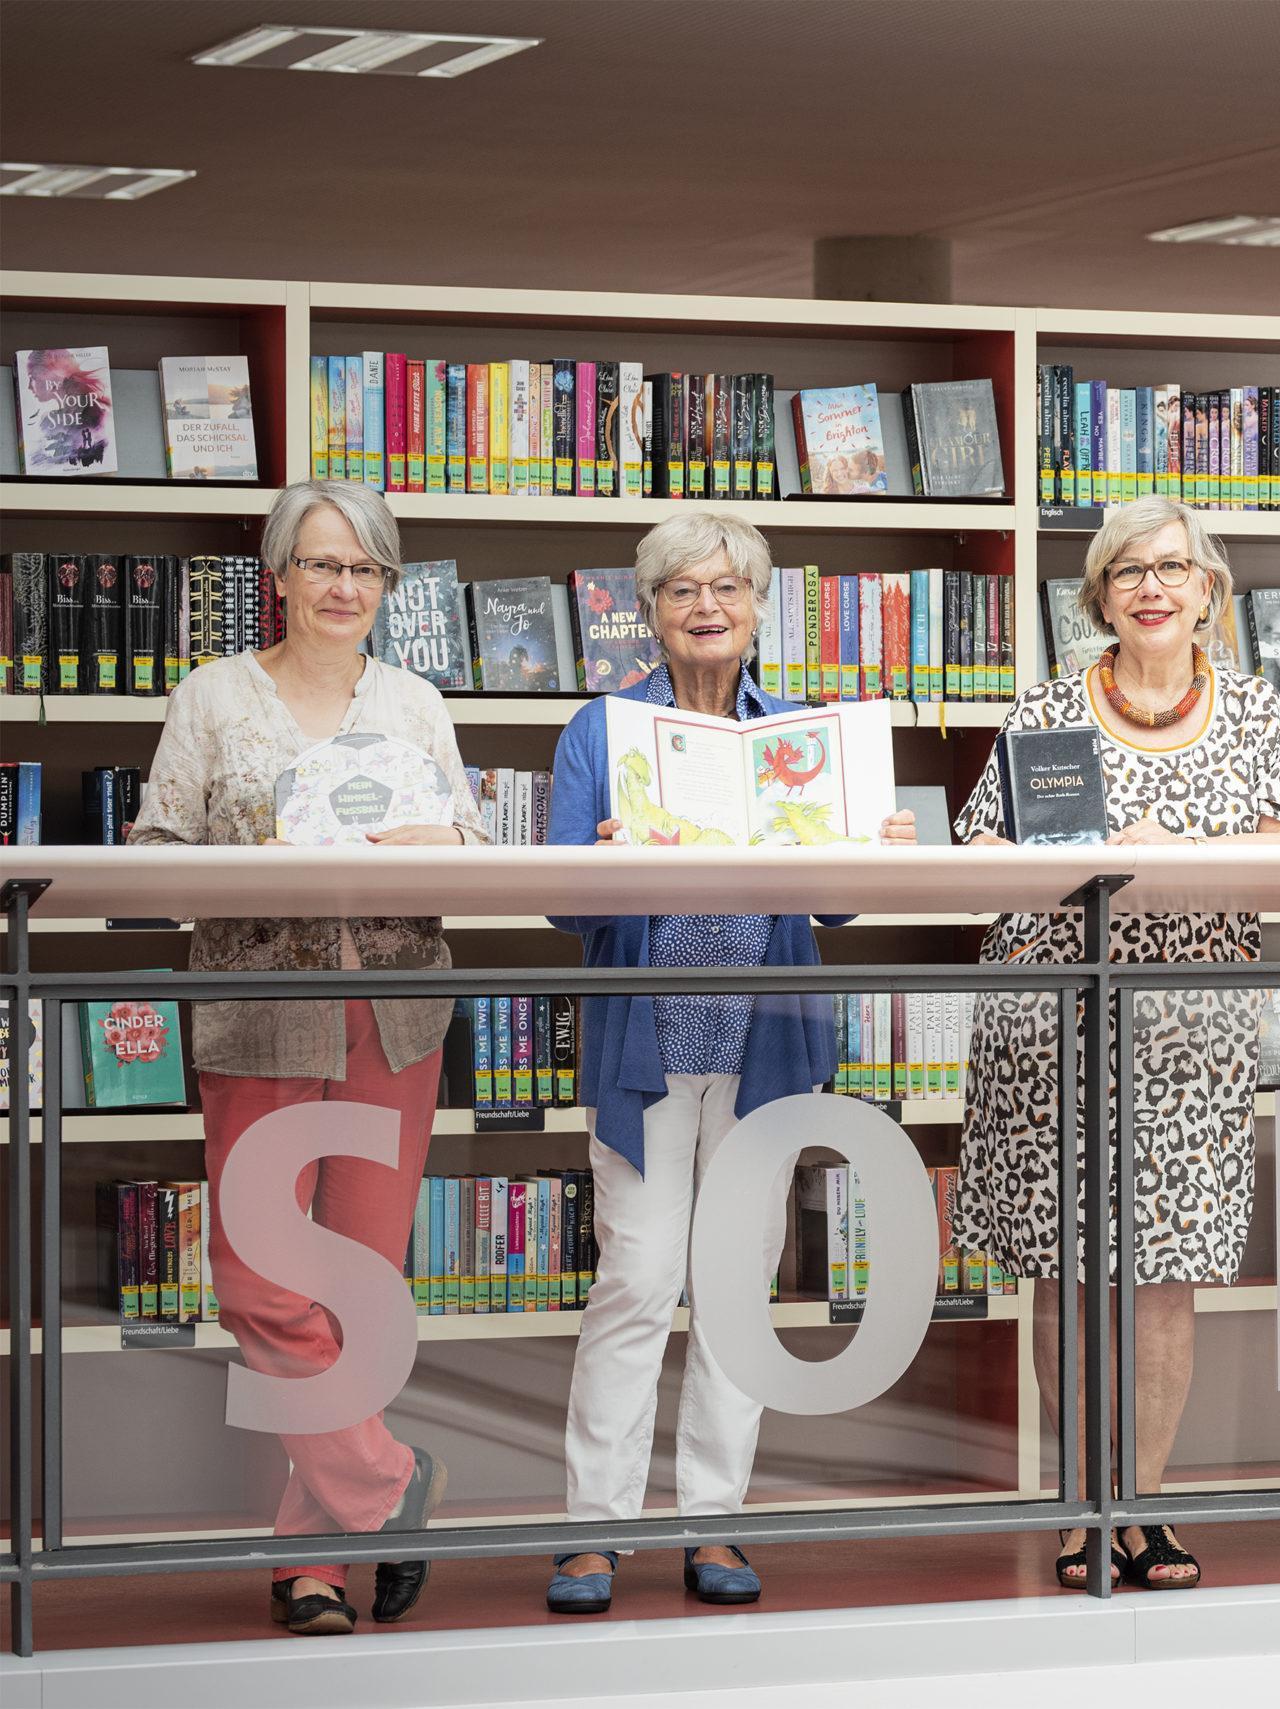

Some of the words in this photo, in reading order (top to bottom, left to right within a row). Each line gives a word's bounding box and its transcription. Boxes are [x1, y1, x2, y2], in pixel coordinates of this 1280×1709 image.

[369, 360, 380, 385] DANTE
[45, 380, 60, 391] BY
[1044, 375, 1052, 407] cecelia
[55, 393, 102, 410] YOUR
[413, 391, 421, 411] BESTE
[690, 390, 704, 424] Heart
[47, 411, 84, 430] SIDE
[817, 404, 862, 424] Sommer
[1044, 408, 1052, 435] ahern
[1080, 411, 1089, 436] LEAH
[1273, 399, 1280, 445] BETRAYED
[183, 423, 202, 432] DER
[826, 424, 869, 443] Brighton
[1094, 425, 1099, 437] NO
[176, 434, 196, 443] DAS
[197, 434, 250, 443] SCHICKSAL
[1170, 433, 1178, 463] ELITE
[193, 445, 215, 454] UND
[217, 445, 234, 454] ICH
[1043, 447, 1051, 470] PERF
[1041, 509, 1063, 518] Englisch
[387, 577, 441, 613] NOT
[484, 598, 527, 622] Nayra
[527, 602, 546, 615] und
[601, 612, 609, 623] A
[611, 611, 638, 623] NEW
[808, 571, 817, 647] PONDEROSA
[389, 610, 449, 639] OVER
[510, 613, 533, 636] Jo
[394, 638, 450, 673] YOU
[974, 641, 985, 652] 17
[987, 641, 998, 652] 17
[1002, 641, 1012, 652] 17
[1030, 765, 1051, 773] Volker
[1052, 763, 1081, 772] Kutscher
[348, 781, 373, 791] MEIN
[1030, 776, 1085, 790] OLYMPIA
[338, 793, 383, 803] HIMMEL-
[336, 804, 387, 816] FUSSBALL
[536, 787, 546, 845] IGHTSONG
[104, 1014, 165, 1030] CINDER
[478, 997, 487, 1030] TWIC
[498, 997, 507, 1031] TWIC
[555, 1010, 571, 1049] EWIG
[115, 1040, 160, 1056] ELLA
[479, 1034, 487, 1053] ME
[499, 1034, 507, 1053] ME
[519, 1034, 527, 1053] ME
[475, 1111, 530, 1120] Freundschaft/Liebe
[478, 1186, 489, 1201] BIT
[943, 1173, 955, 1225] Edelherb
[855, 1198, 866, 1219] LOVE
[164, 1221, 176, 1249] LOVE
[495, 1234, 505, 1265] ROOFER
[935, 1297, 975, 1307] ndschaft/Liebe
[122, 1327, 180, 1336] Freundschaft/Liebe
